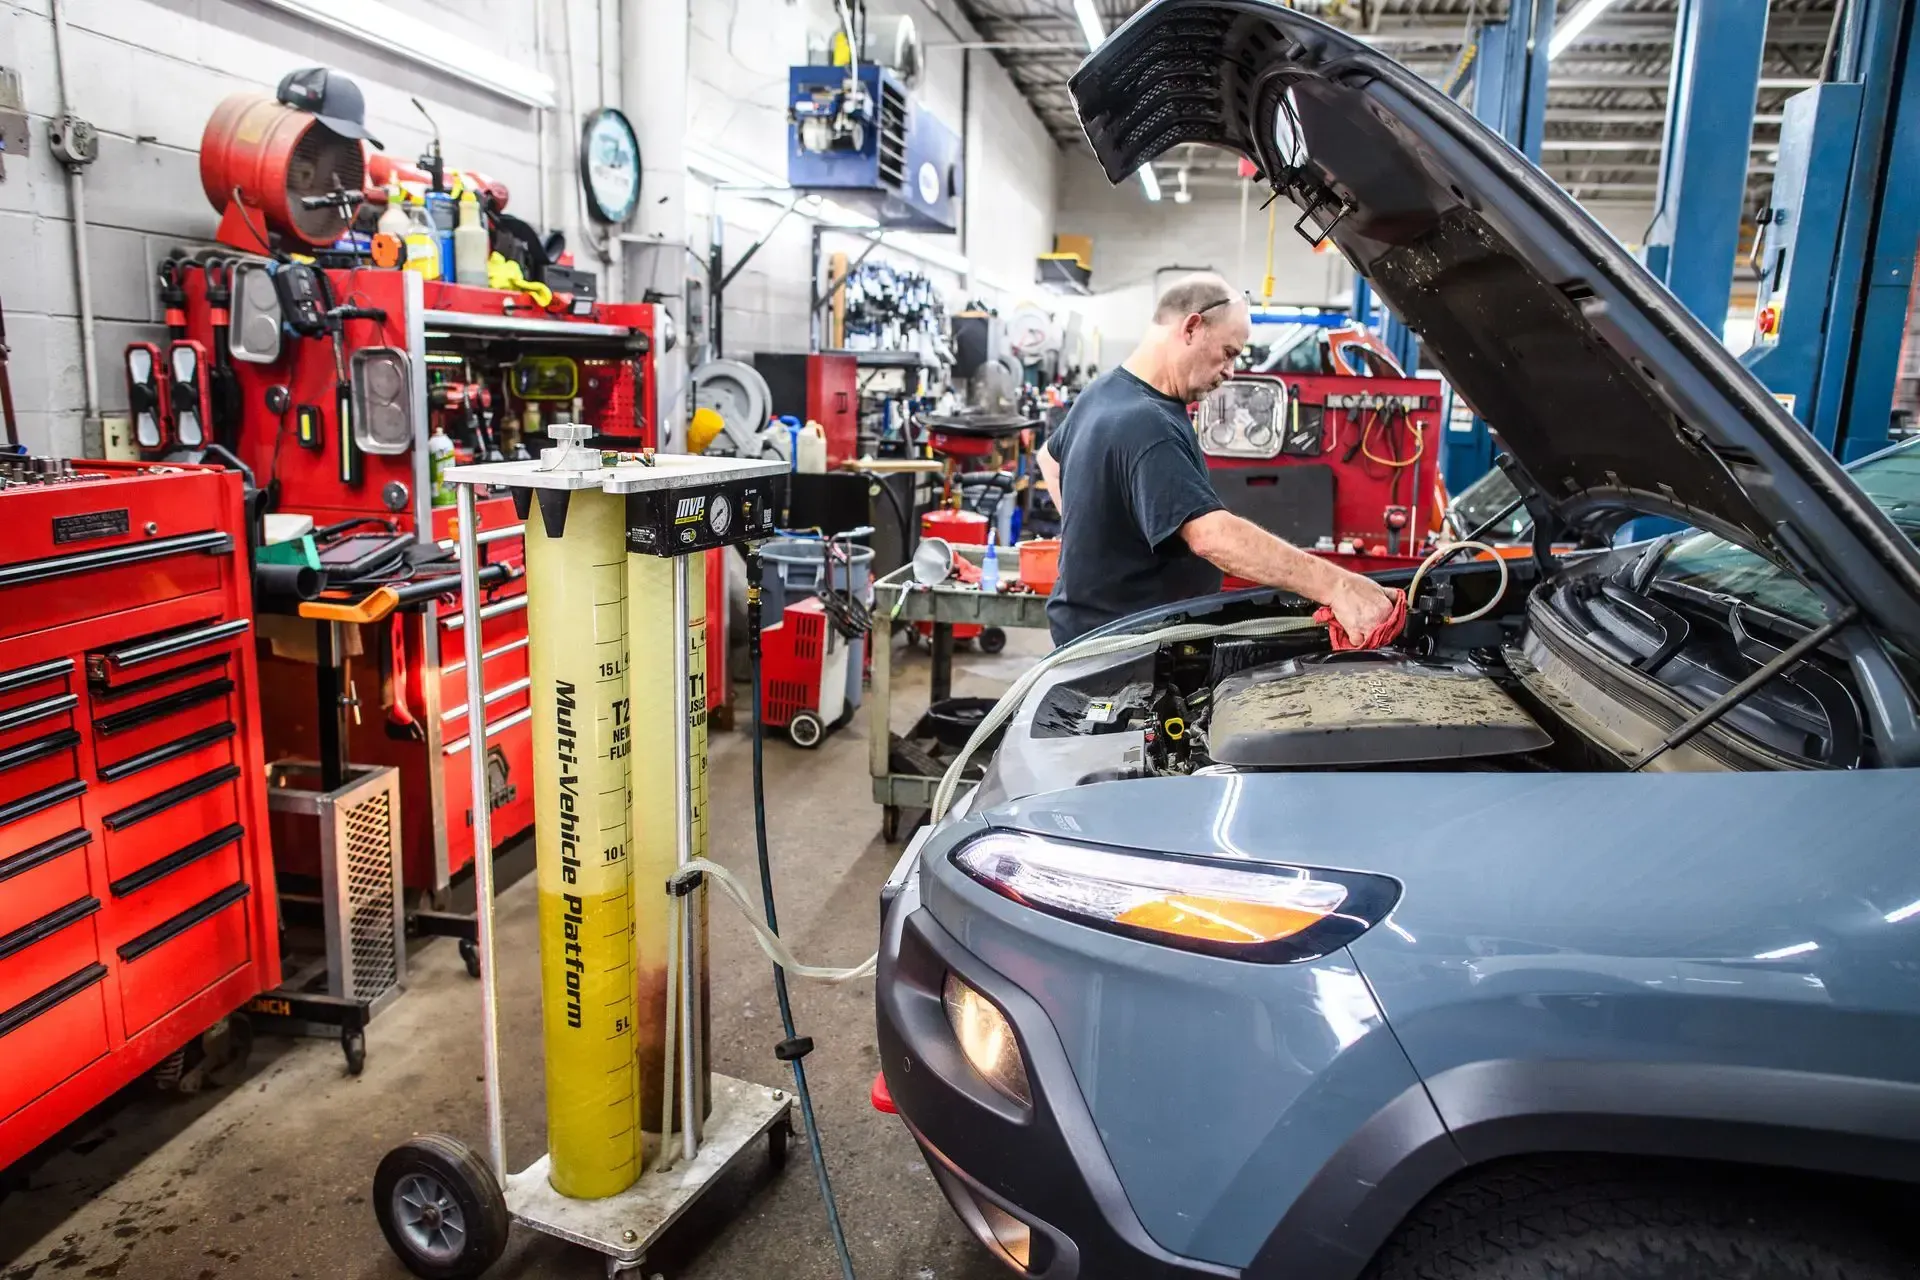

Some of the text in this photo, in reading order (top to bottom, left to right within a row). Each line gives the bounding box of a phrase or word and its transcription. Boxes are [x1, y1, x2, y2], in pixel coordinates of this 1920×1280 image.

[676, 496, 705, 518] MVP
[697, 509, 705, 521] 2
[599, 660, 621, 677] 15 L
[689, 673, 705, 697] T1
[612, 697, 630, 726] T2
[613, 724, 631, 743] NEW
[556, 680, 584, 1028] Multi-Vehicle Platform
[604, 844, 626, 861] 10 L
[616, 1019, 623, 1032] 5
